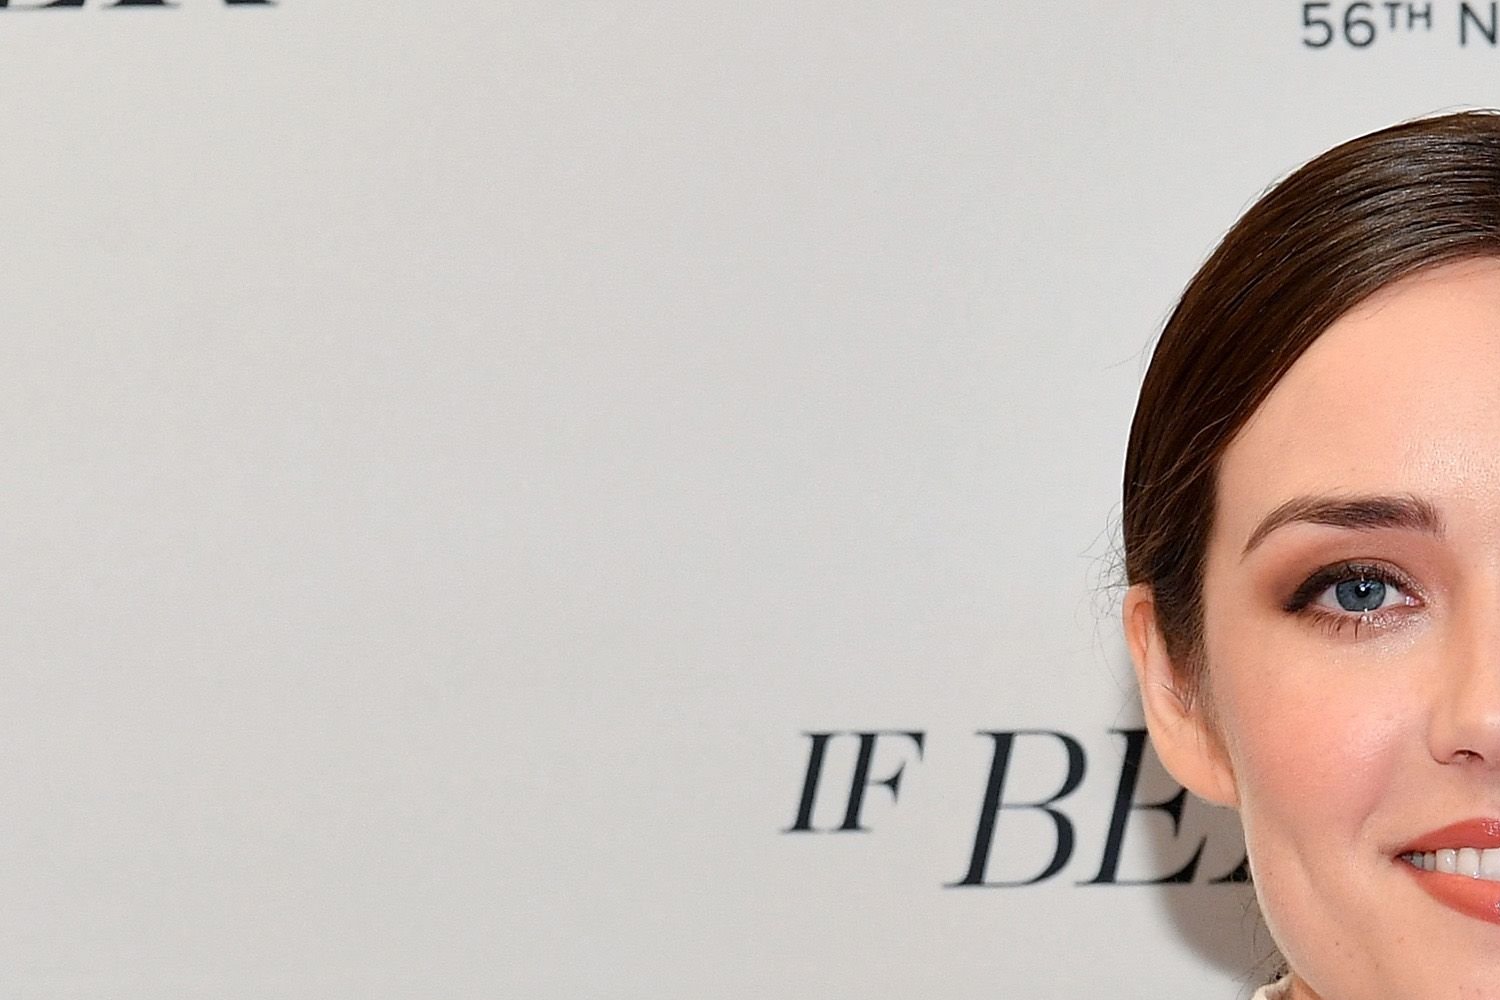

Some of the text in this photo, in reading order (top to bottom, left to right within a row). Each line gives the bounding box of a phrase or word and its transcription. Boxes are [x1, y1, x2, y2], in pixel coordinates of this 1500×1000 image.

[1301, 0, 1434, 50] 56TH
[780, 729, 927, 834] IF
[942, 728, 1254, 889] BE
